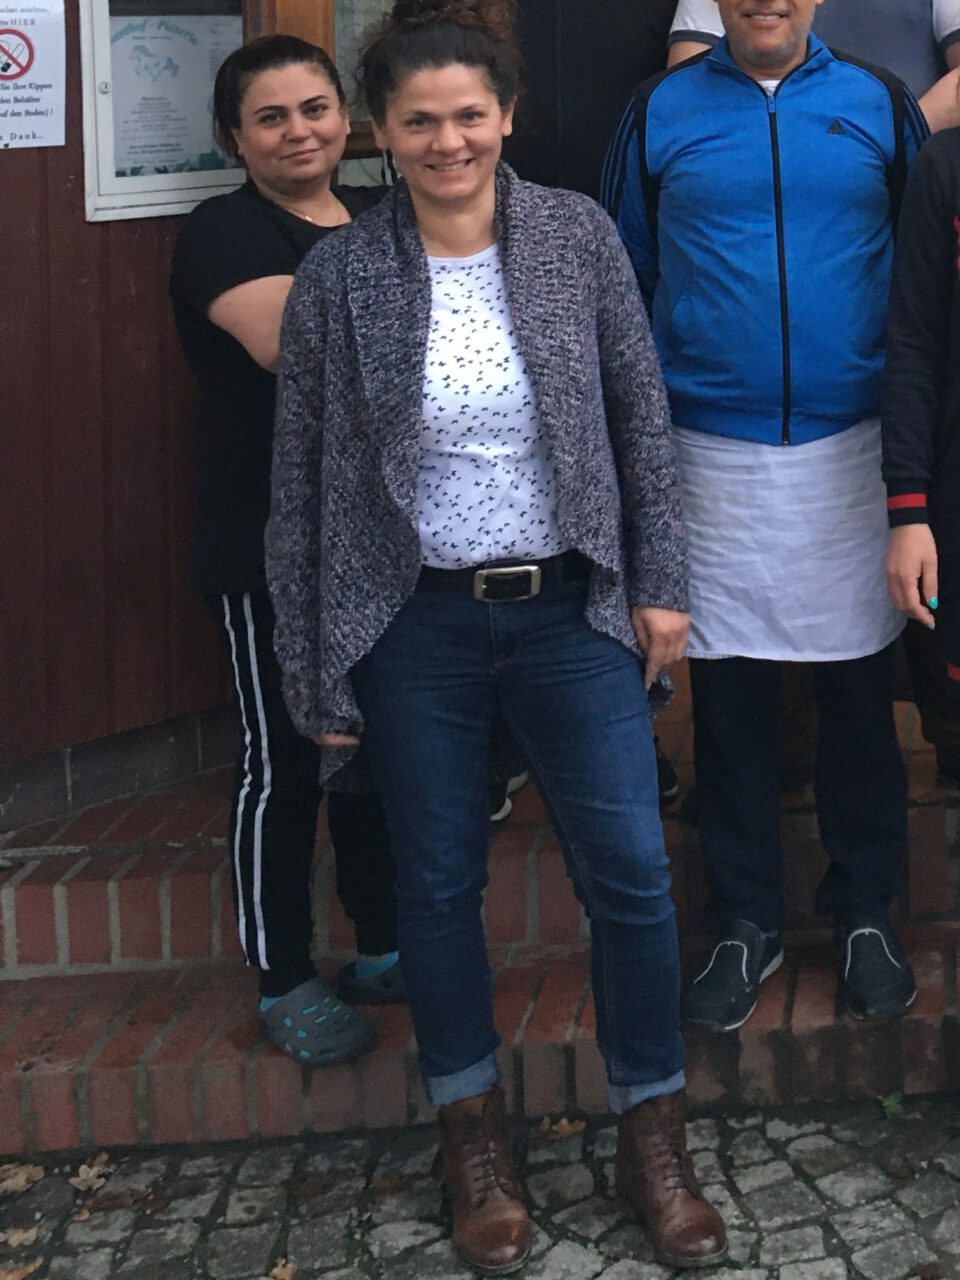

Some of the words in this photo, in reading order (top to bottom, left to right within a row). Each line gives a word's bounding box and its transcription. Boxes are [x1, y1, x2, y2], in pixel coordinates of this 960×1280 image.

[13, 82, 26, 90] Ihre
[29, 82, 52, 92] Kippen
[13, 95, 40, 104] Behälter
